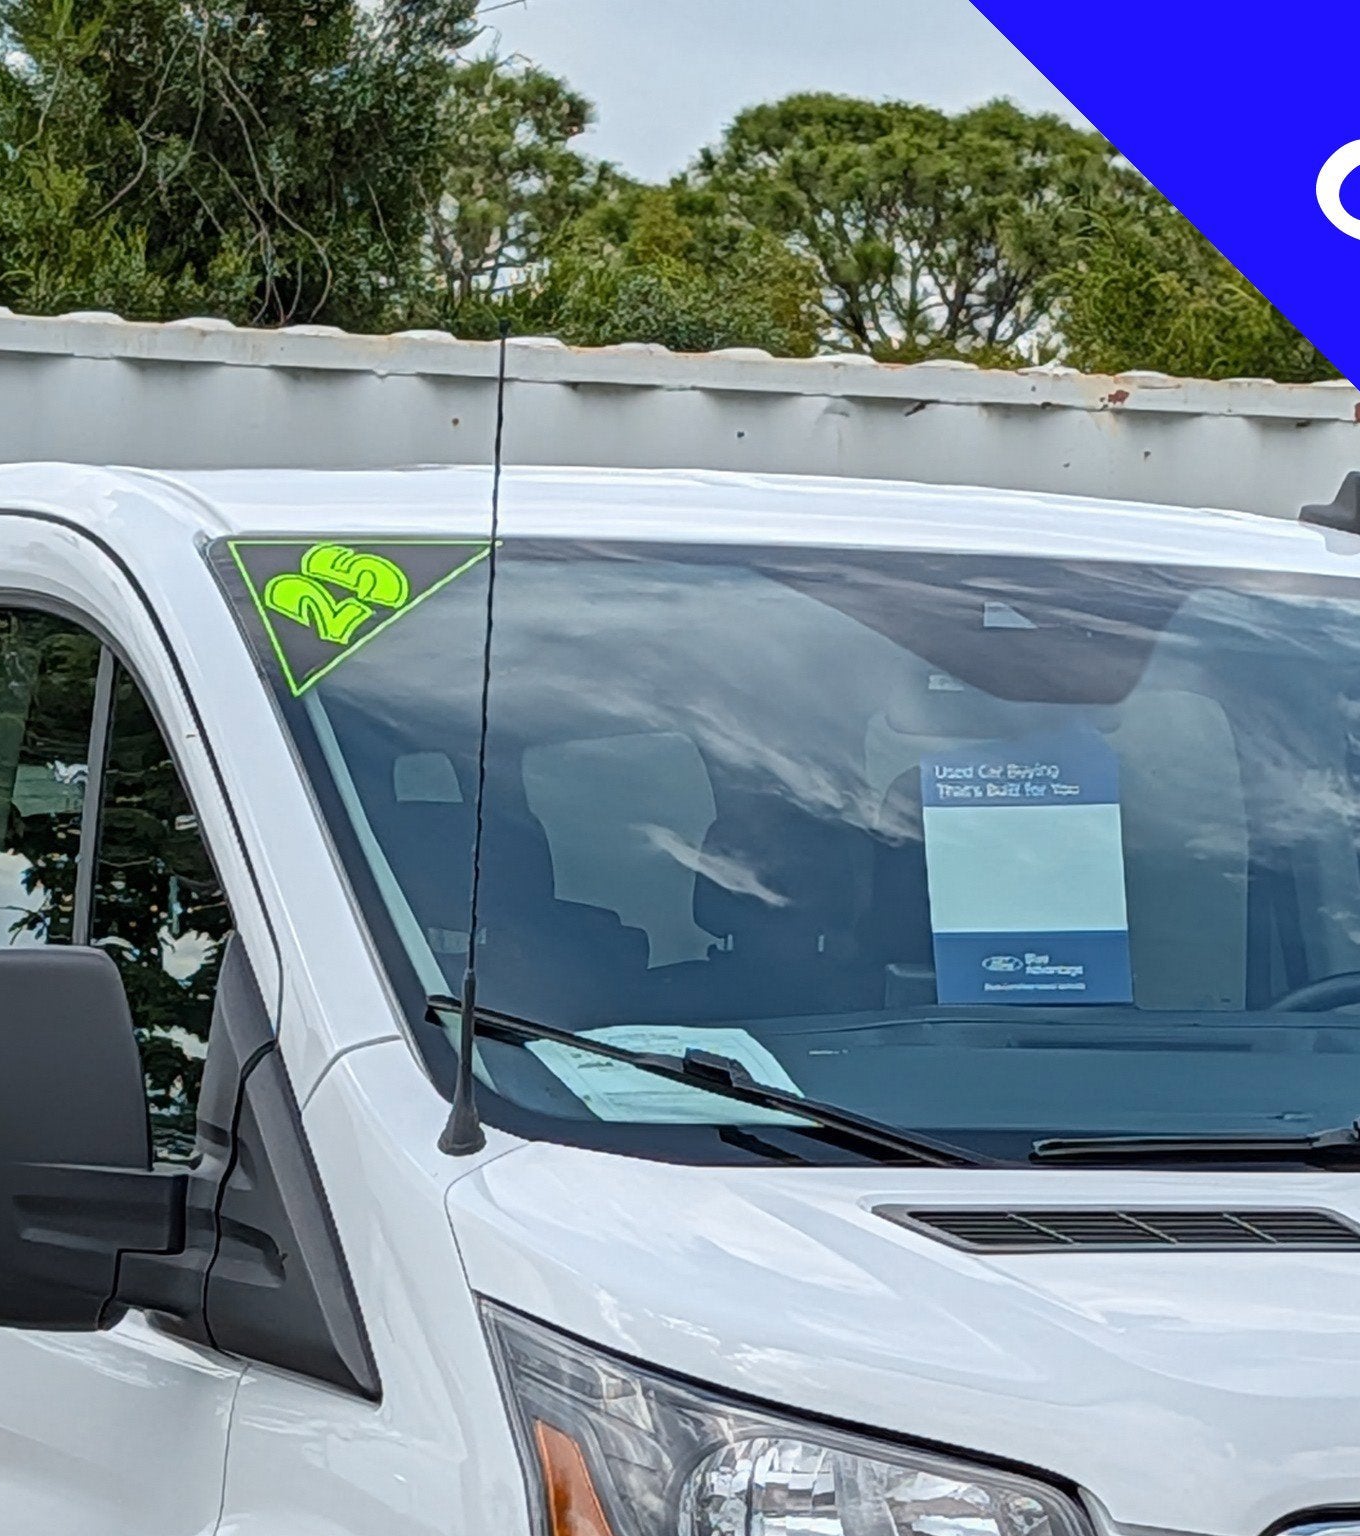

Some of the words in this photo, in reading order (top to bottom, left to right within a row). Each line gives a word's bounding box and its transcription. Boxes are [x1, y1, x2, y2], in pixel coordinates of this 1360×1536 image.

[264, 541, 410, 645] 25
[934, 764, 974, 779] Used
[978, 763, 1003, 779] Car
[1007, 762, 1060, 780] Buying
[1024, 781, 1047, 798] for
